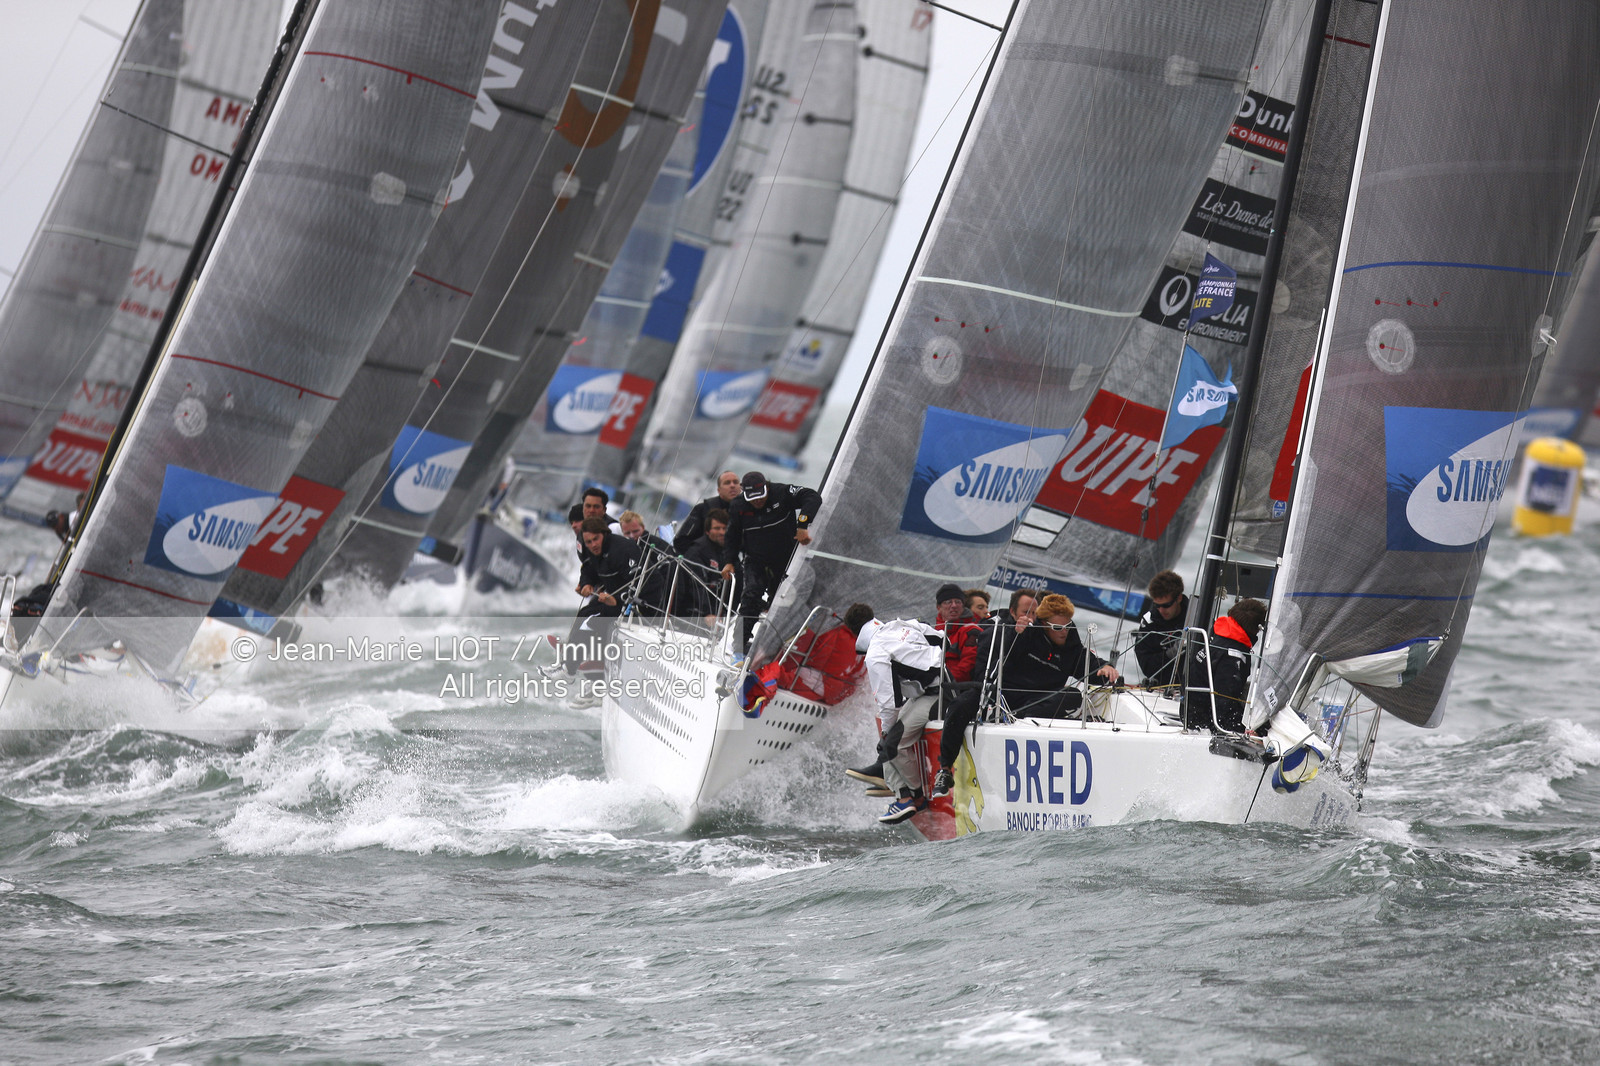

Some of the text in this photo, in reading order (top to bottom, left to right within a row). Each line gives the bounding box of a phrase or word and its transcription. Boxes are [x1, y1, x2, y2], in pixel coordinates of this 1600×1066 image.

[1200, 192, 1227, 214] Les
[1225, 201, 1261, 226] Dunes
[1203, 287, 1233, 297] FRANCE
[1011, 571, 1048, 591] France
[1005, 739, 1093, 805] BRED
[1006, 811, 1040, 831] BANQUE
